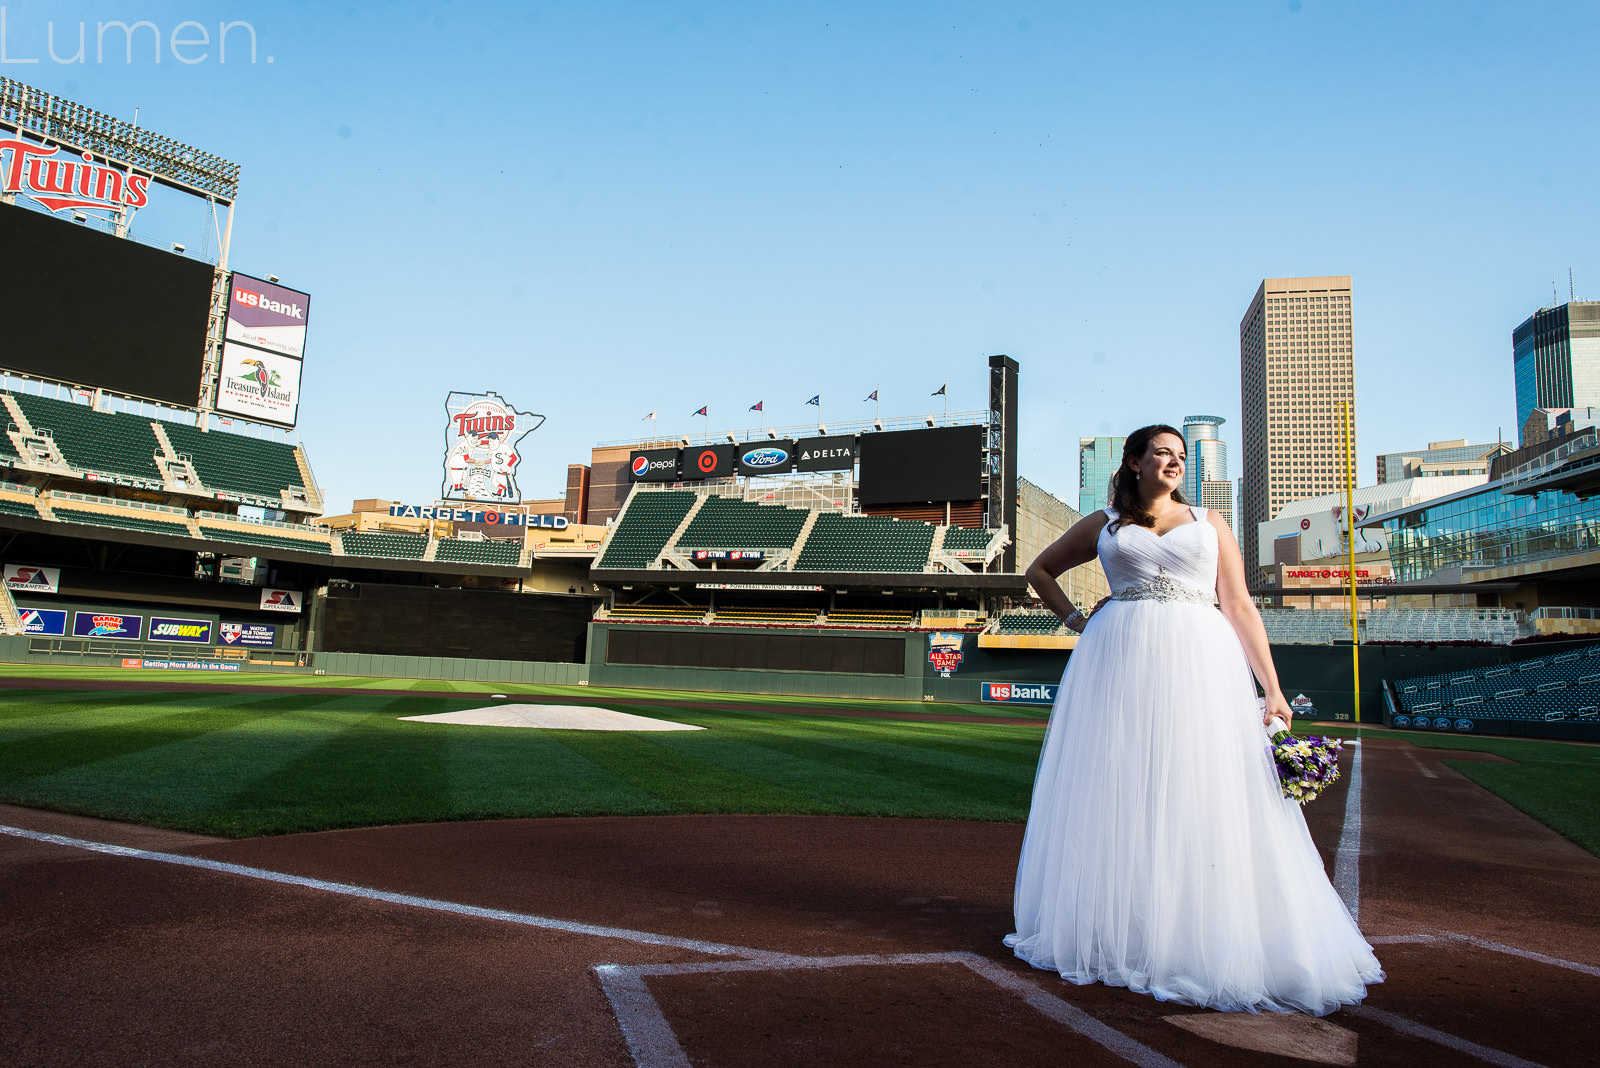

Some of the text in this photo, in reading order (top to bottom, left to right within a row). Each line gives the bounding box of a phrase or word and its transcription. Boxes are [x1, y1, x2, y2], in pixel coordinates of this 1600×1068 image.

[0, 139, 150, 208] Twins
[225, 376, 291, 402] Treasure Island
[225, 390, 252, 399] RESORT
[263, 399, 290, 407] CASINO
[453, 411, 515, 438] Twins
[750, 450, 778, 465] Ford
[813, 448, 851, 459] DELTA
[649, 458, 676, 471] pepsi
[390, 504, 569, 530] TARGET FIELD
[1286, 570, 1322, 578] TARGET
[1374, 577, 1397, 585] Clips
[262, 603, 297, 611] SUPERAMERICA
[93, 616, 123, 624] BARREL
[152, 623, 209, 637] SUBWAY
[144, 660, 168, 669] Getting
